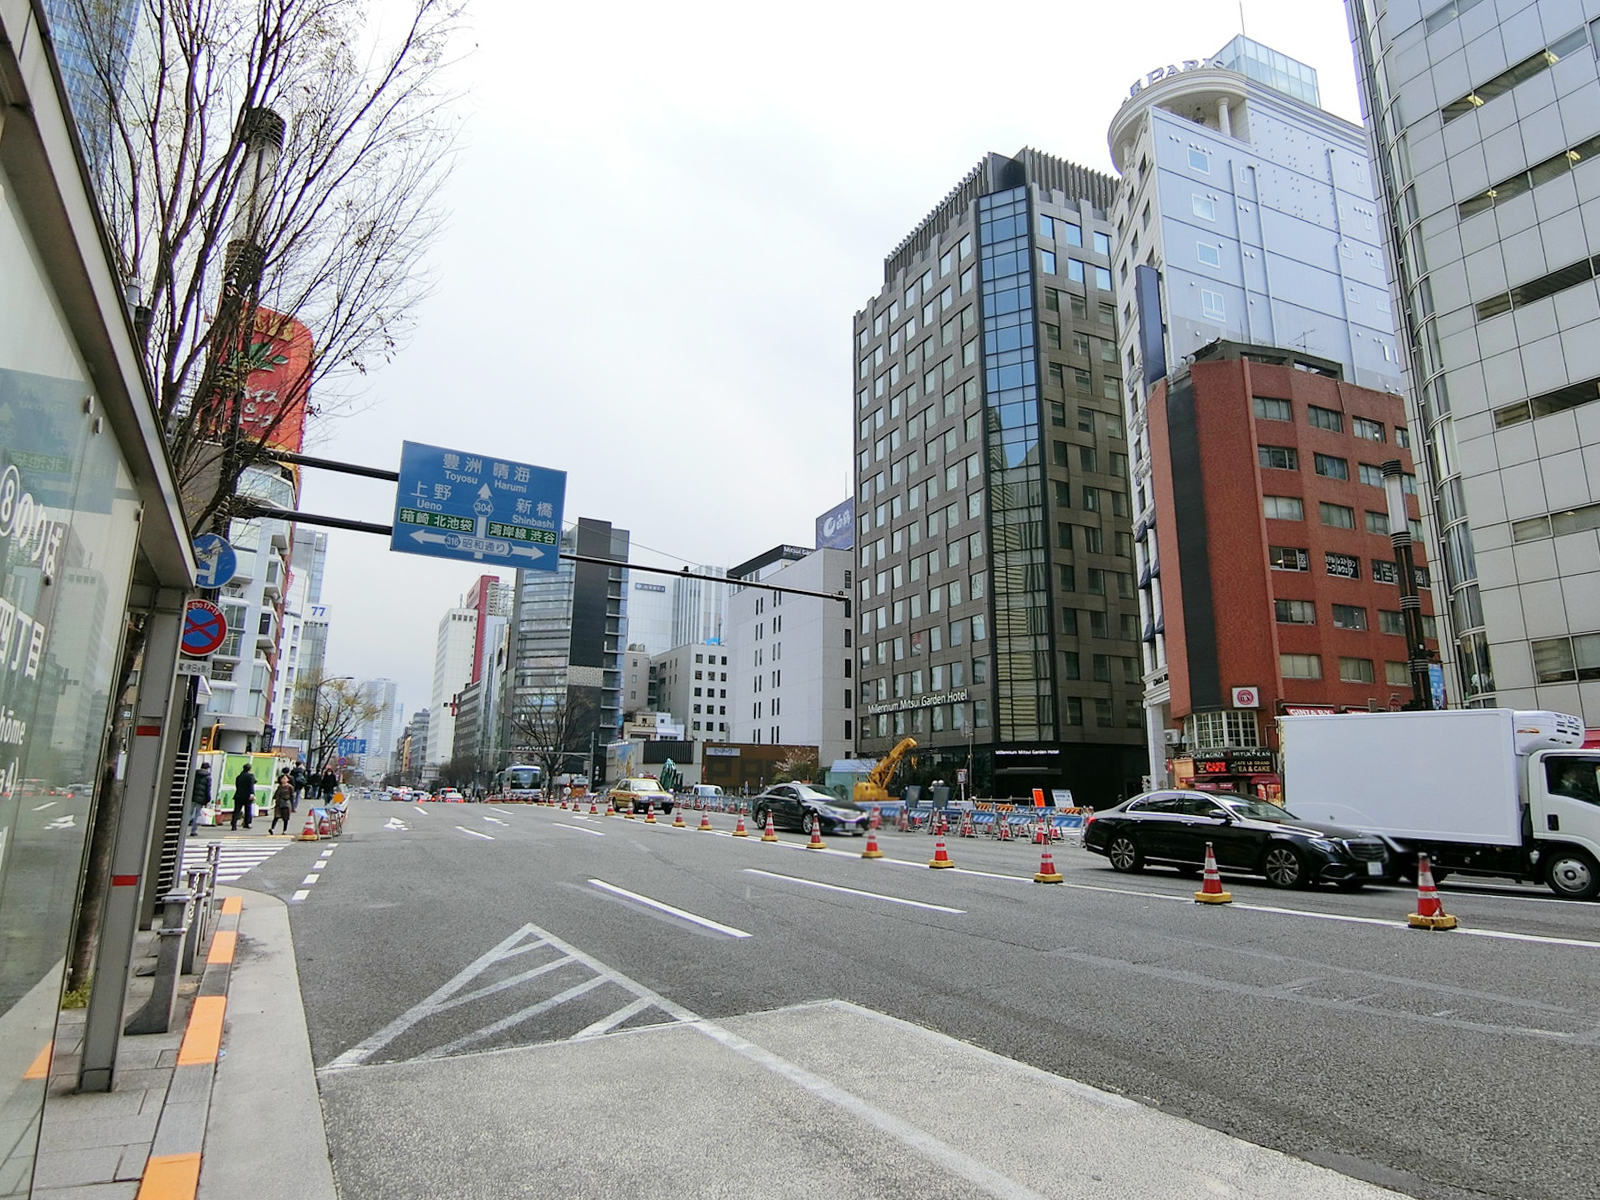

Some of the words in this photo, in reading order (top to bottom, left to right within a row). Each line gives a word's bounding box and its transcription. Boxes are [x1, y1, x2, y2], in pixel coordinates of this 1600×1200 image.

[442, 453, 482, 474] 豊洲
[493, 462, 531, 483] 晴海
[445, 470, 478, 485] Toyosu
[494, 481, 527, 494] Harumi
[410, 481, 452, 501] 上野
[417, 499, 443, 511] Ueno
[475, 502, 491, 514] 304
[516, 498, 553, 518] 新橋
[401, 509, 429, 525] 箱崎
[434, 516, 473, 532] 北池袋
[512, 515, 555, 529] Shinbashi
[446, 536, 458, 546] 316
[489, 523, 527, 541] 湾岸線
[530, 530, 556, 545] 渋谷
[462, 538, 506, 554] 昭和通り
[311, 606, 326, 617] 77
[868, 701, 899, 714] Millennium
[900, 696, 920, 710] Mitsui
[921, 693, 946, 707] Garden
[947, 688, 968, 703] Hotel
[1205, 761, 1227, 773] CAFE
[1253, 765, 1271, 773] CAKE
